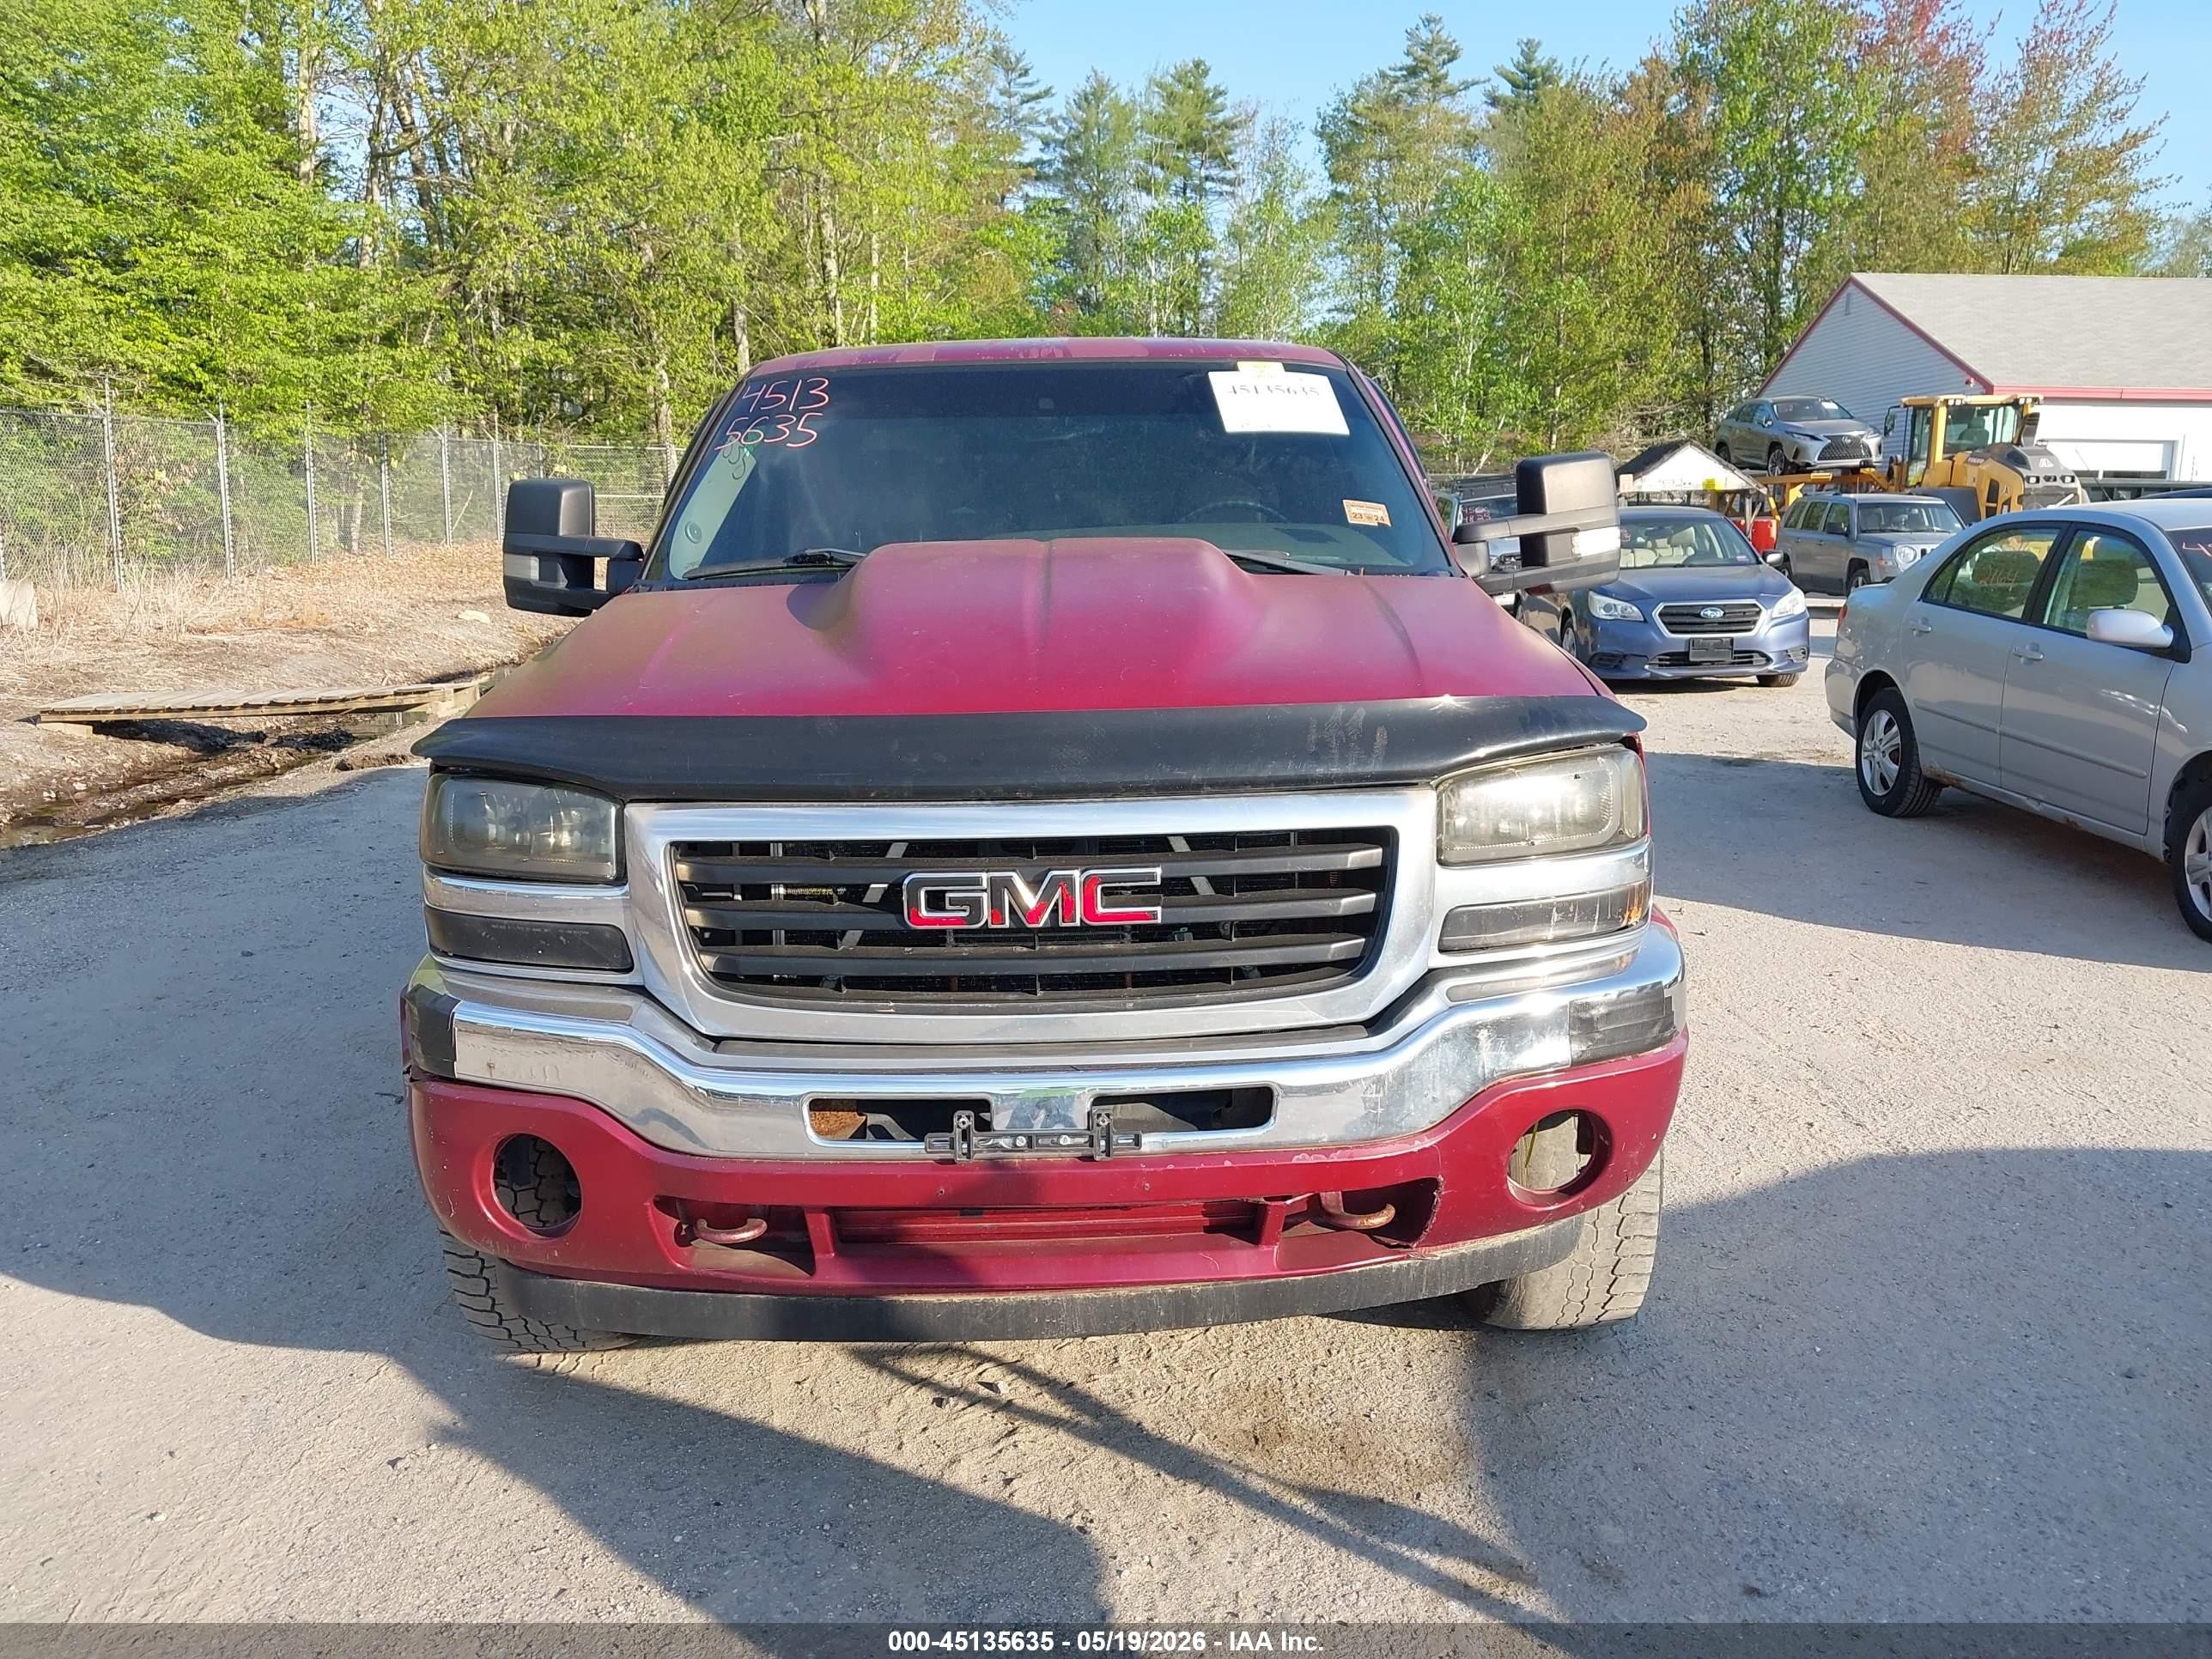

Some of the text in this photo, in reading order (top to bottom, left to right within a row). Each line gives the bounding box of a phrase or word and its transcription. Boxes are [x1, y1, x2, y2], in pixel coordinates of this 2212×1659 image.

[742, 377, 830, 413] 4513
[714, 412, 824, 451] 5635
[902, 866, 1162, 928] GMC
